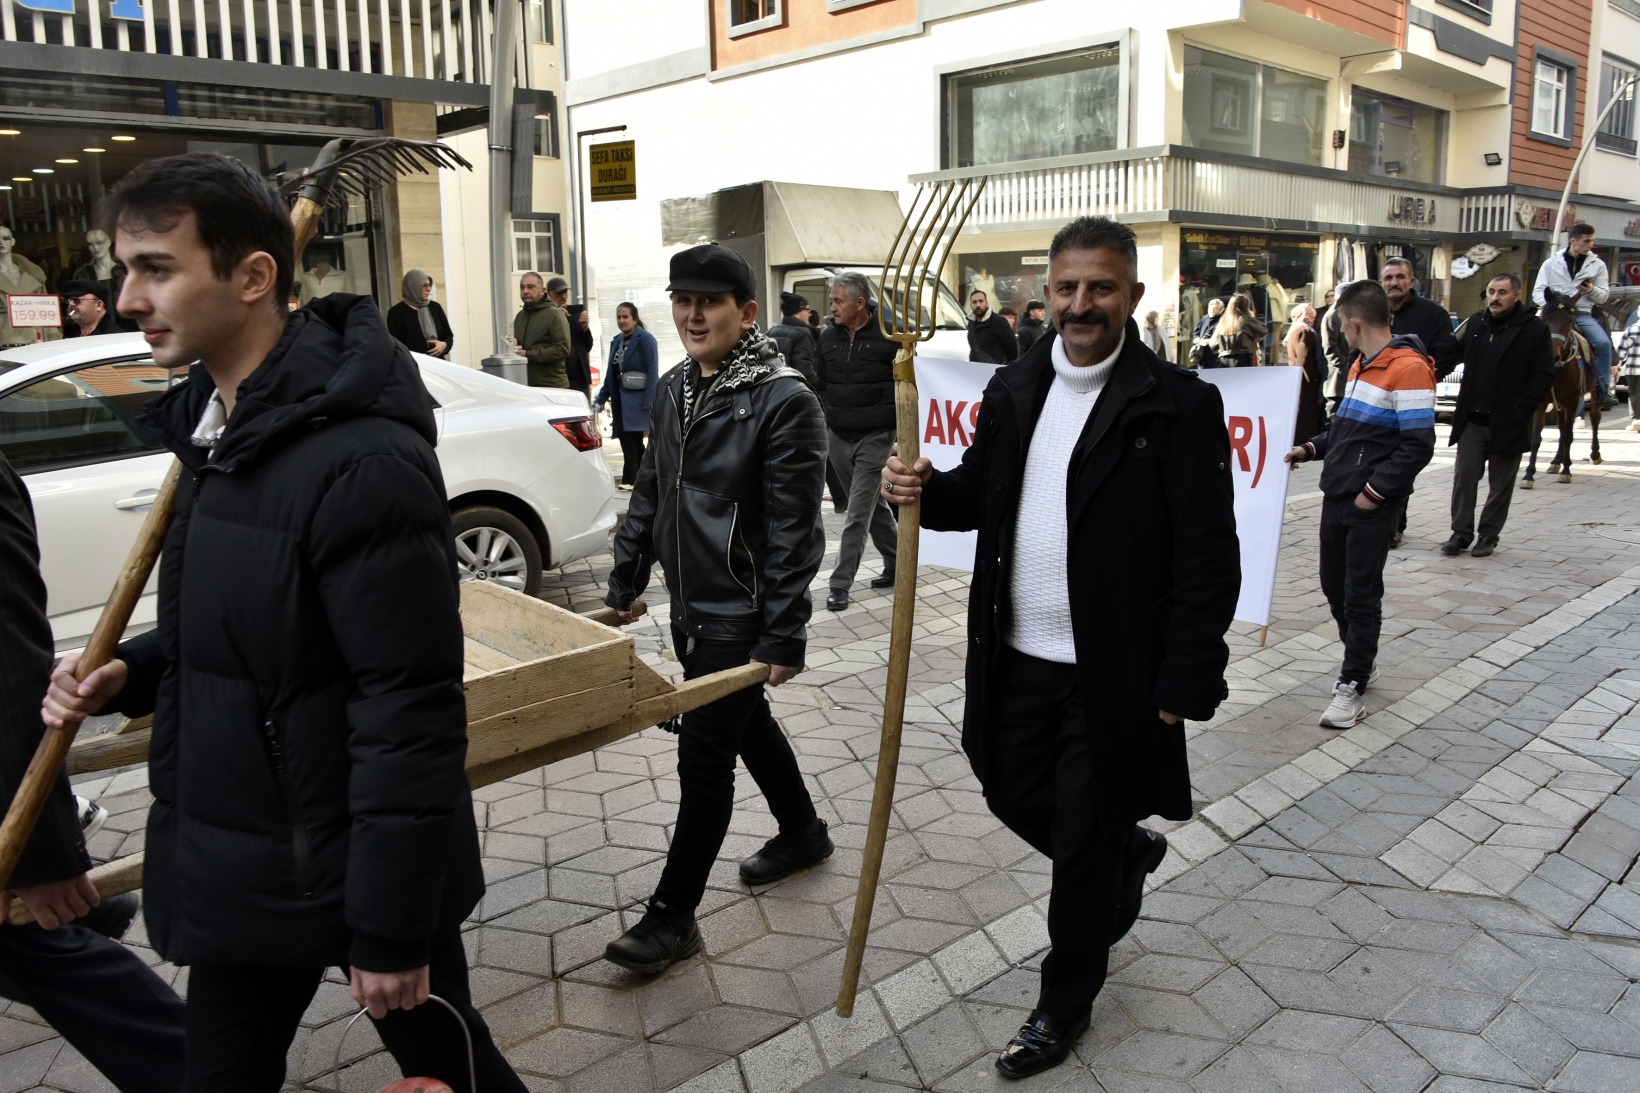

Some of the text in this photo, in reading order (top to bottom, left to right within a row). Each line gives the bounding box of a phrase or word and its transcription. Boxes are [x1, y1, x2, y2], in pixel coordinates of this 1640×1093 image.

[591, 150, 609, 165] SEFA
[598, 165, 627, 183] DURAĞI
[1388, 195, 1436, 224] URBA
[1385, 245, 1403, 257] URBA
[14, 310, 56, 320] 159.99
